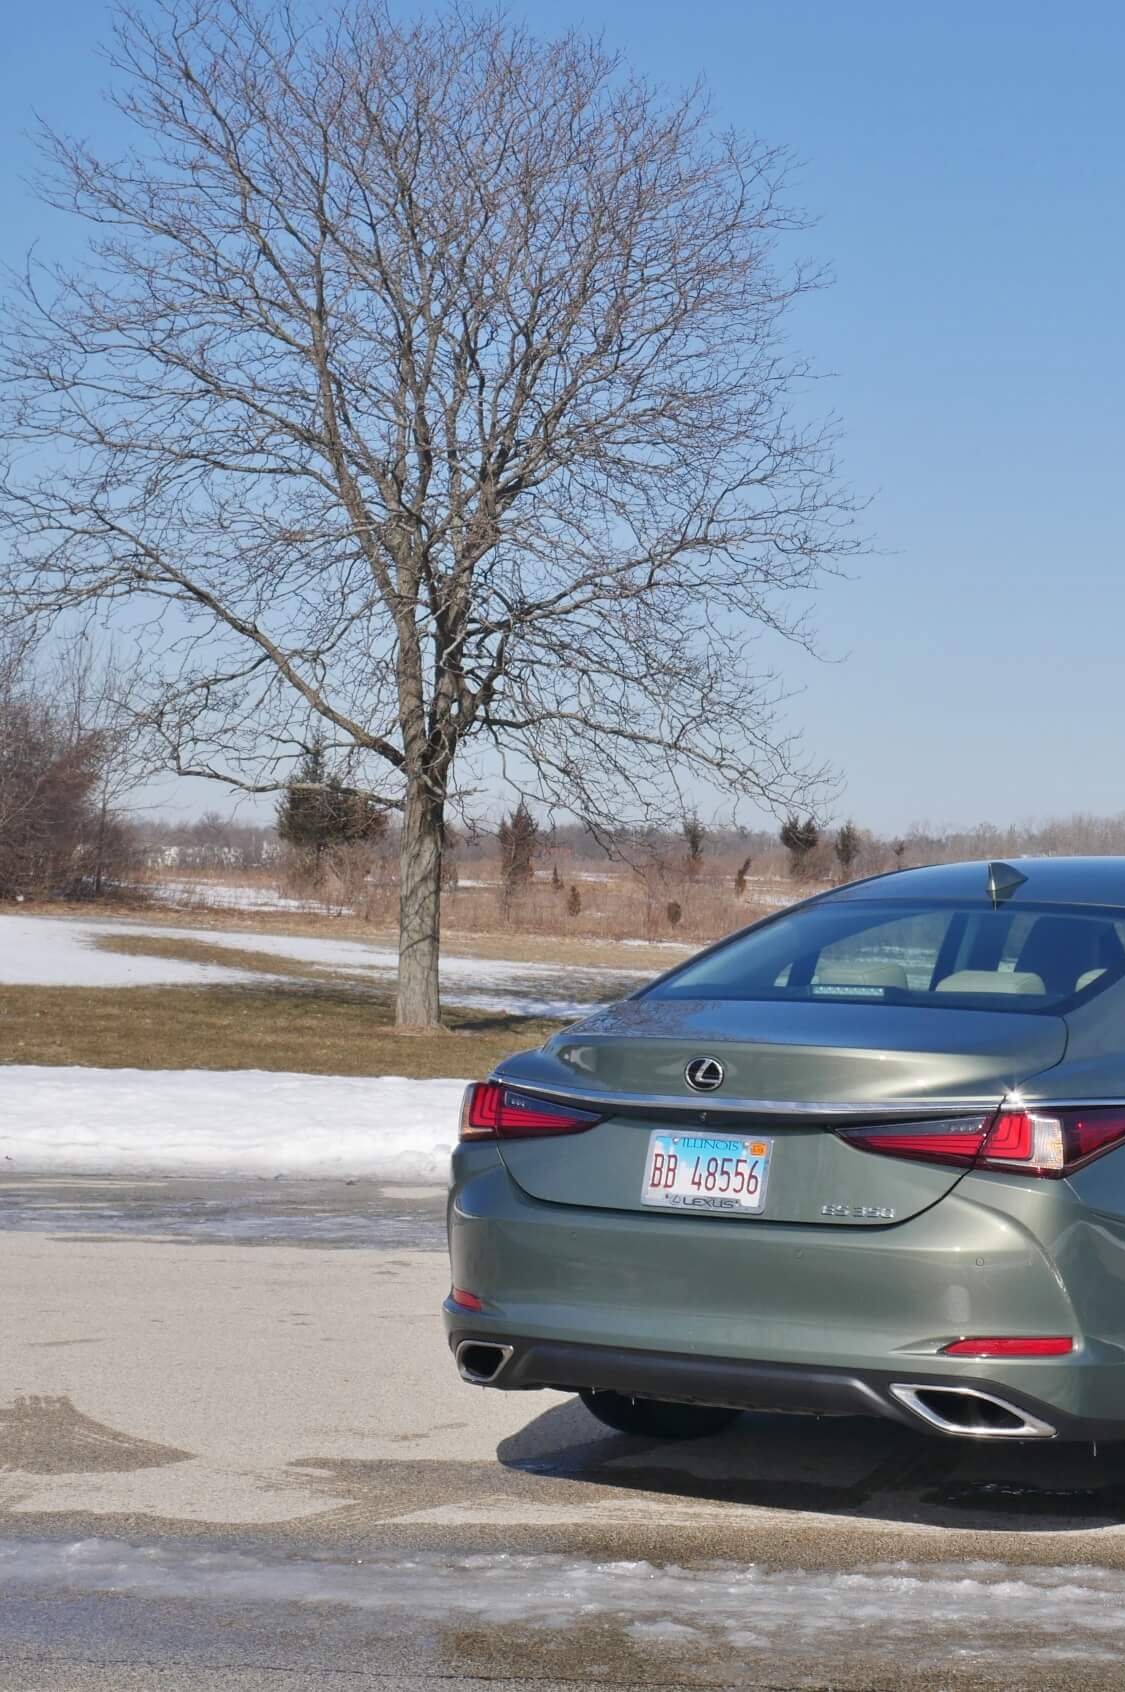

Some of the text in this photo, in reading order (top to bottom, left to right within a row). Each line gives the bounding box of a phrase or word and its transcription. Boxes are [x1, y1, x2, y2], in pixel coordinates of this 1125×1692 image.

[682, 1137, 739, 1152] ILLINOIS
[650, 1153, 759, 1195] BB 48556
[683, 1197, 734, 1208] LEXUS
[821, 1204, 895, 1218] ES 350
